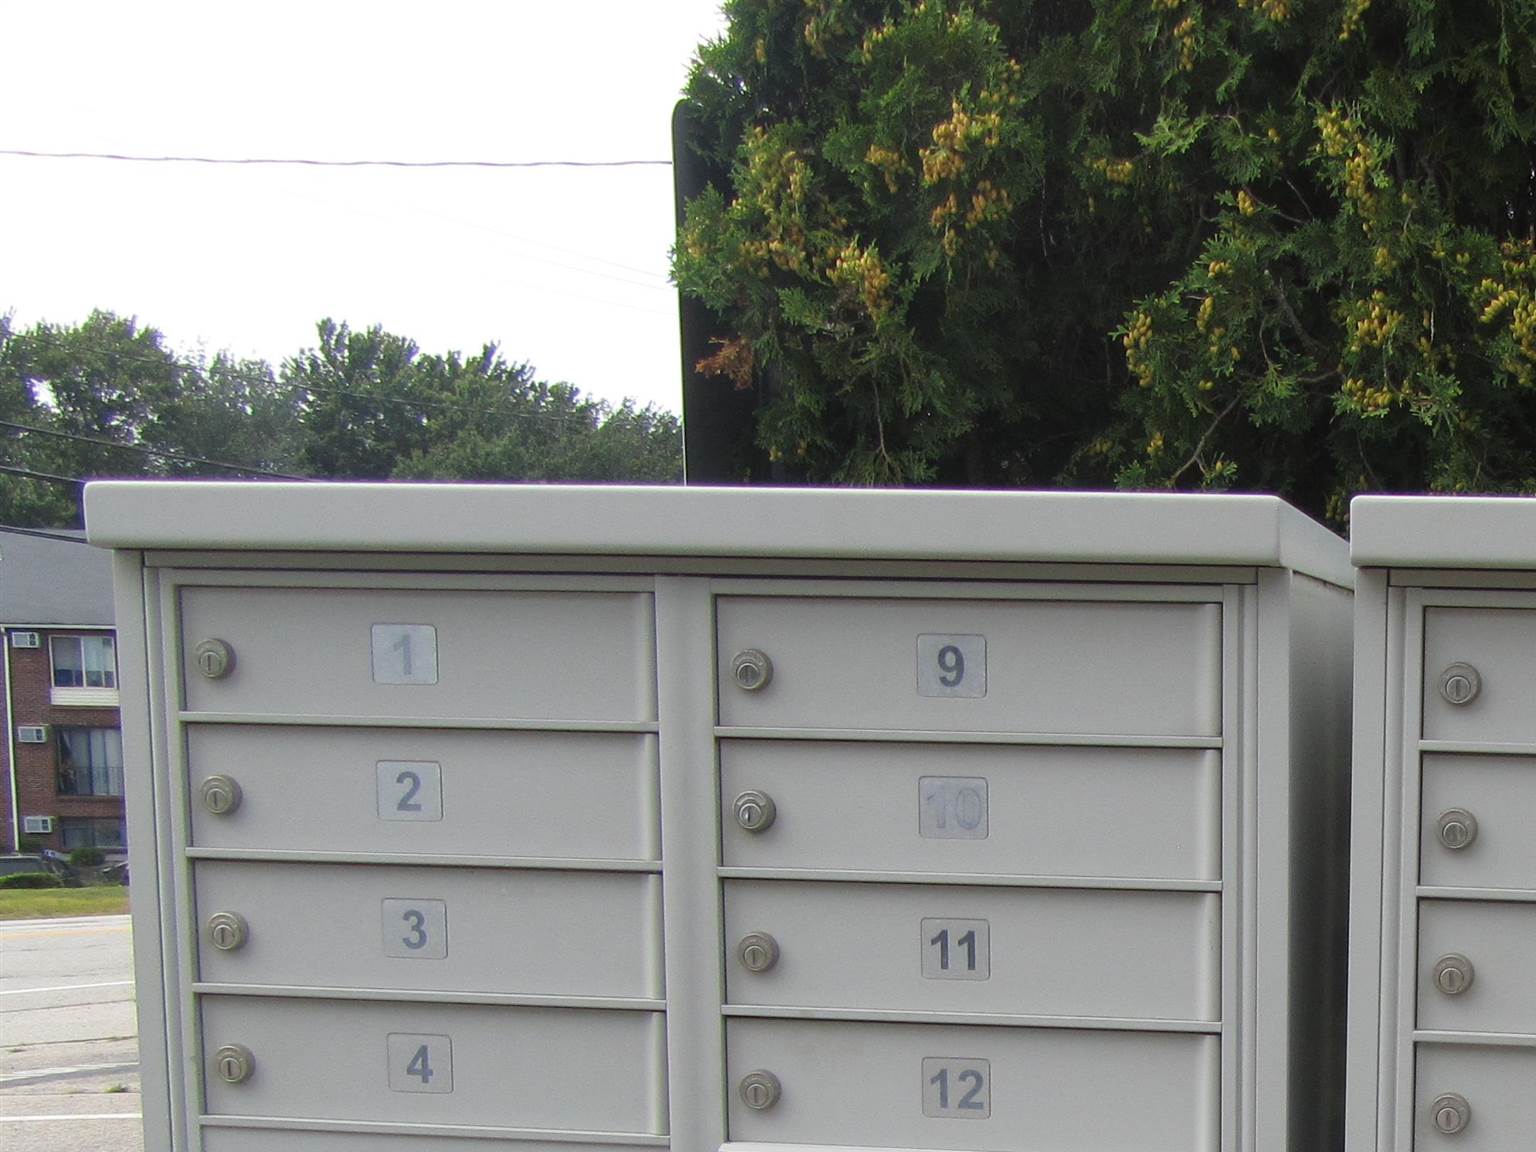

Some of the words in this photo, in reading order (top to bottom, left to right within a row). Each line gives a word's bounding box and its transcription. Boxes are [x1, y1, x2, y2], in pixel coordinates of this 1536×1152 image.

[393, 635, 411, 675] 1
[938, 646, 964, 686] 9
[396, 772, 422, 811] 2
[926, 792, 983, 829] 10
[402, 910, 427, 949] 3
[930, 930, 977, 970] 11
[407, 1045, 433, 1083] 4
[930, 1069, 983, 1109] 12
